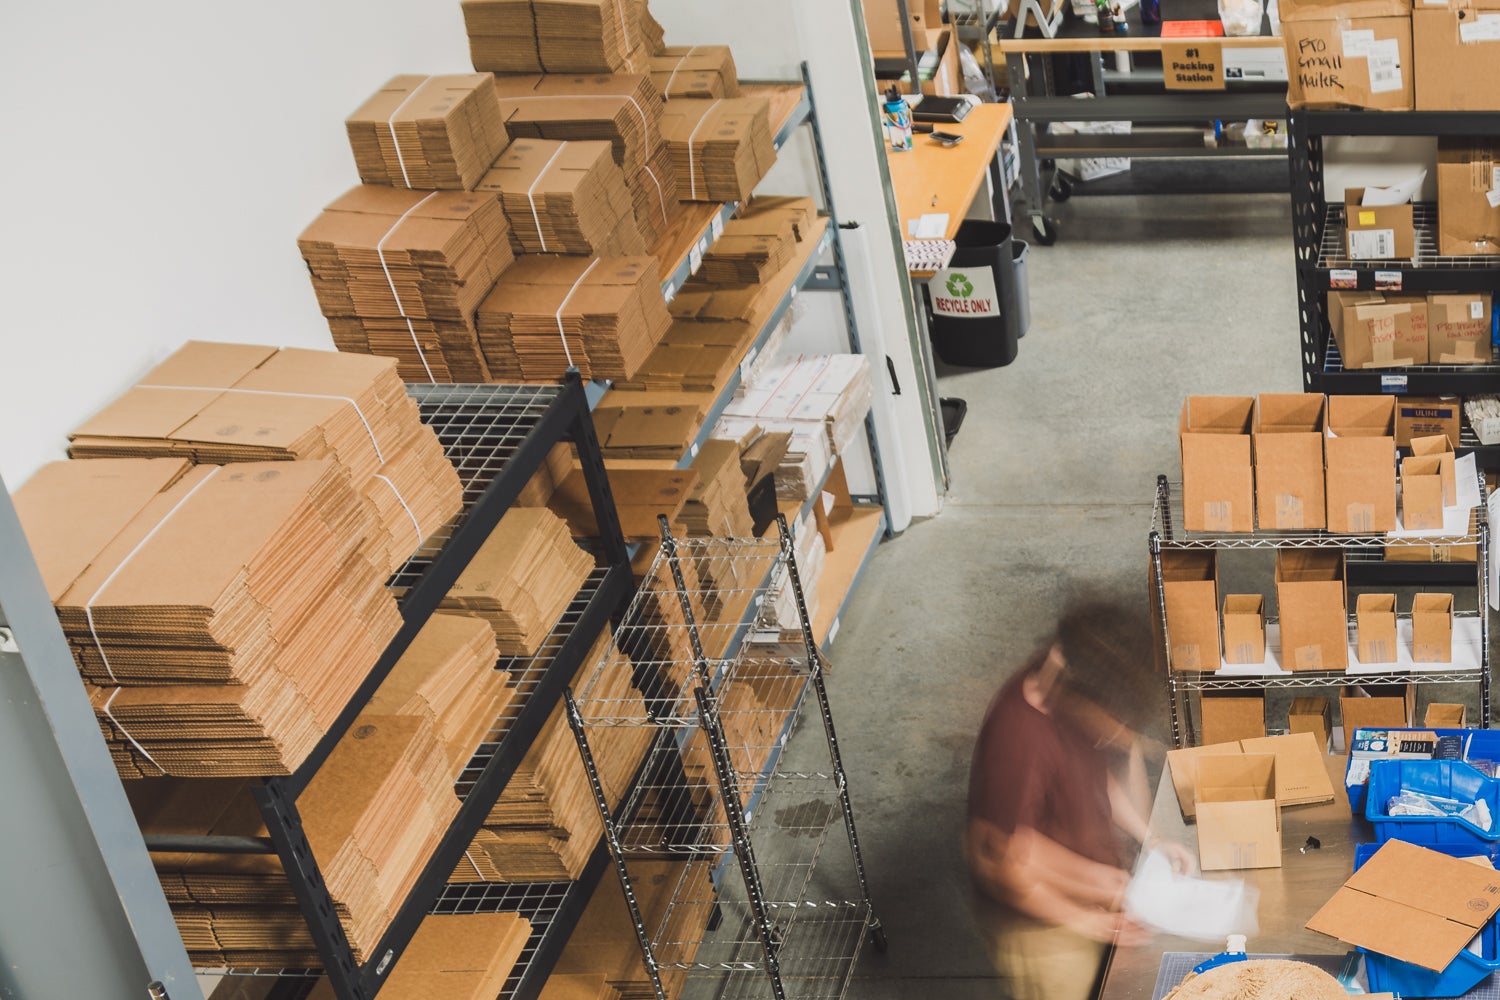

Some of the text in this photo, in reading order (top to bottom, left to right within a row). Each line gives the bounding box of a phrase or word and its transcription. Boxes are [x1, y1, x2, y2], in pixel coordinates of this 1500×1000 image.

[1298, 38, 1326, 53] FTO
[1186, 49, 1199, 58] #1
[1172, 62, 1215, 72] Packing
[1176, 73, 1213, 82] Station
[936, 297, 991, 313] RECYCLE ONLY
